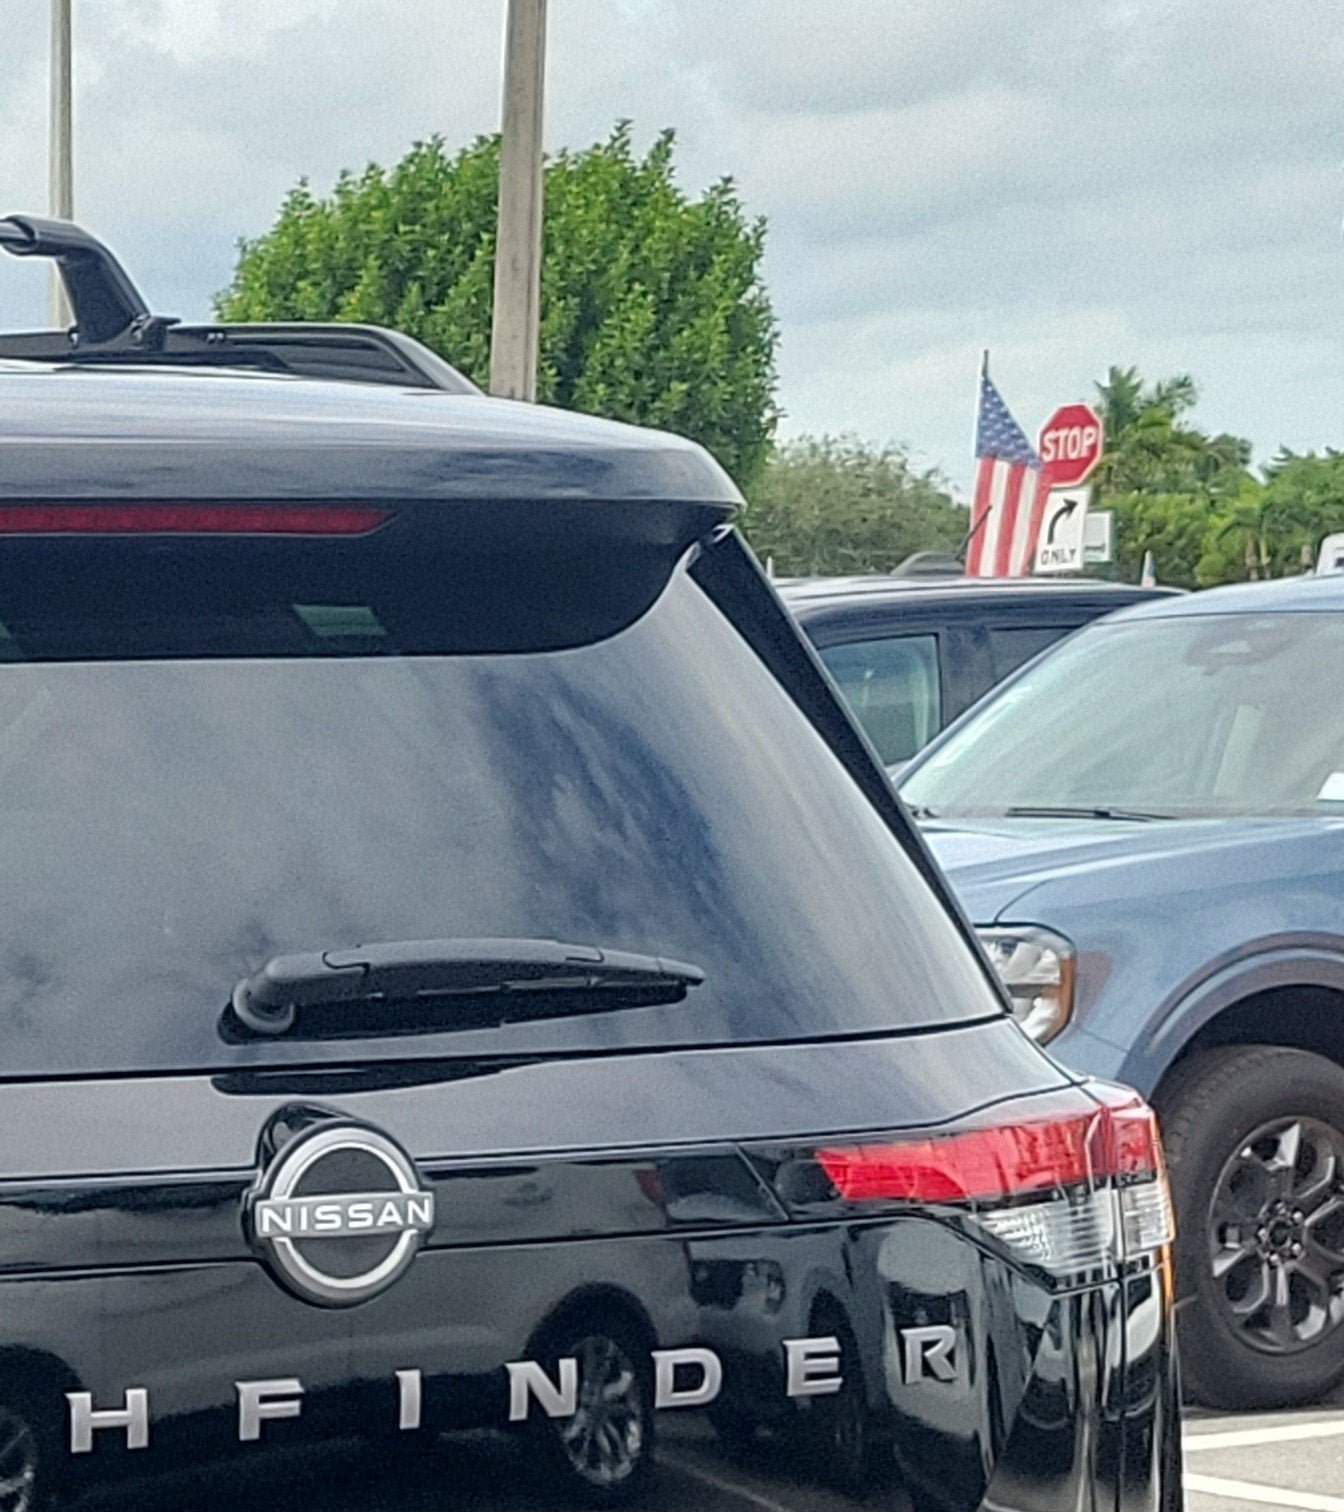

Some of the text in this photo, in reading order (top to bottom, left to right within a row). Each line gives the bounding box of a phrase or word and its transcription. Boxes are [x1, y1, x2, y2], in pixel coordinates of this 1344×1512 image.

[1042, 426, 1098, 462] STOP
[1040, 548, 1076, 566] ONLY
[261, 1198, 431, 1233] NISSAN
